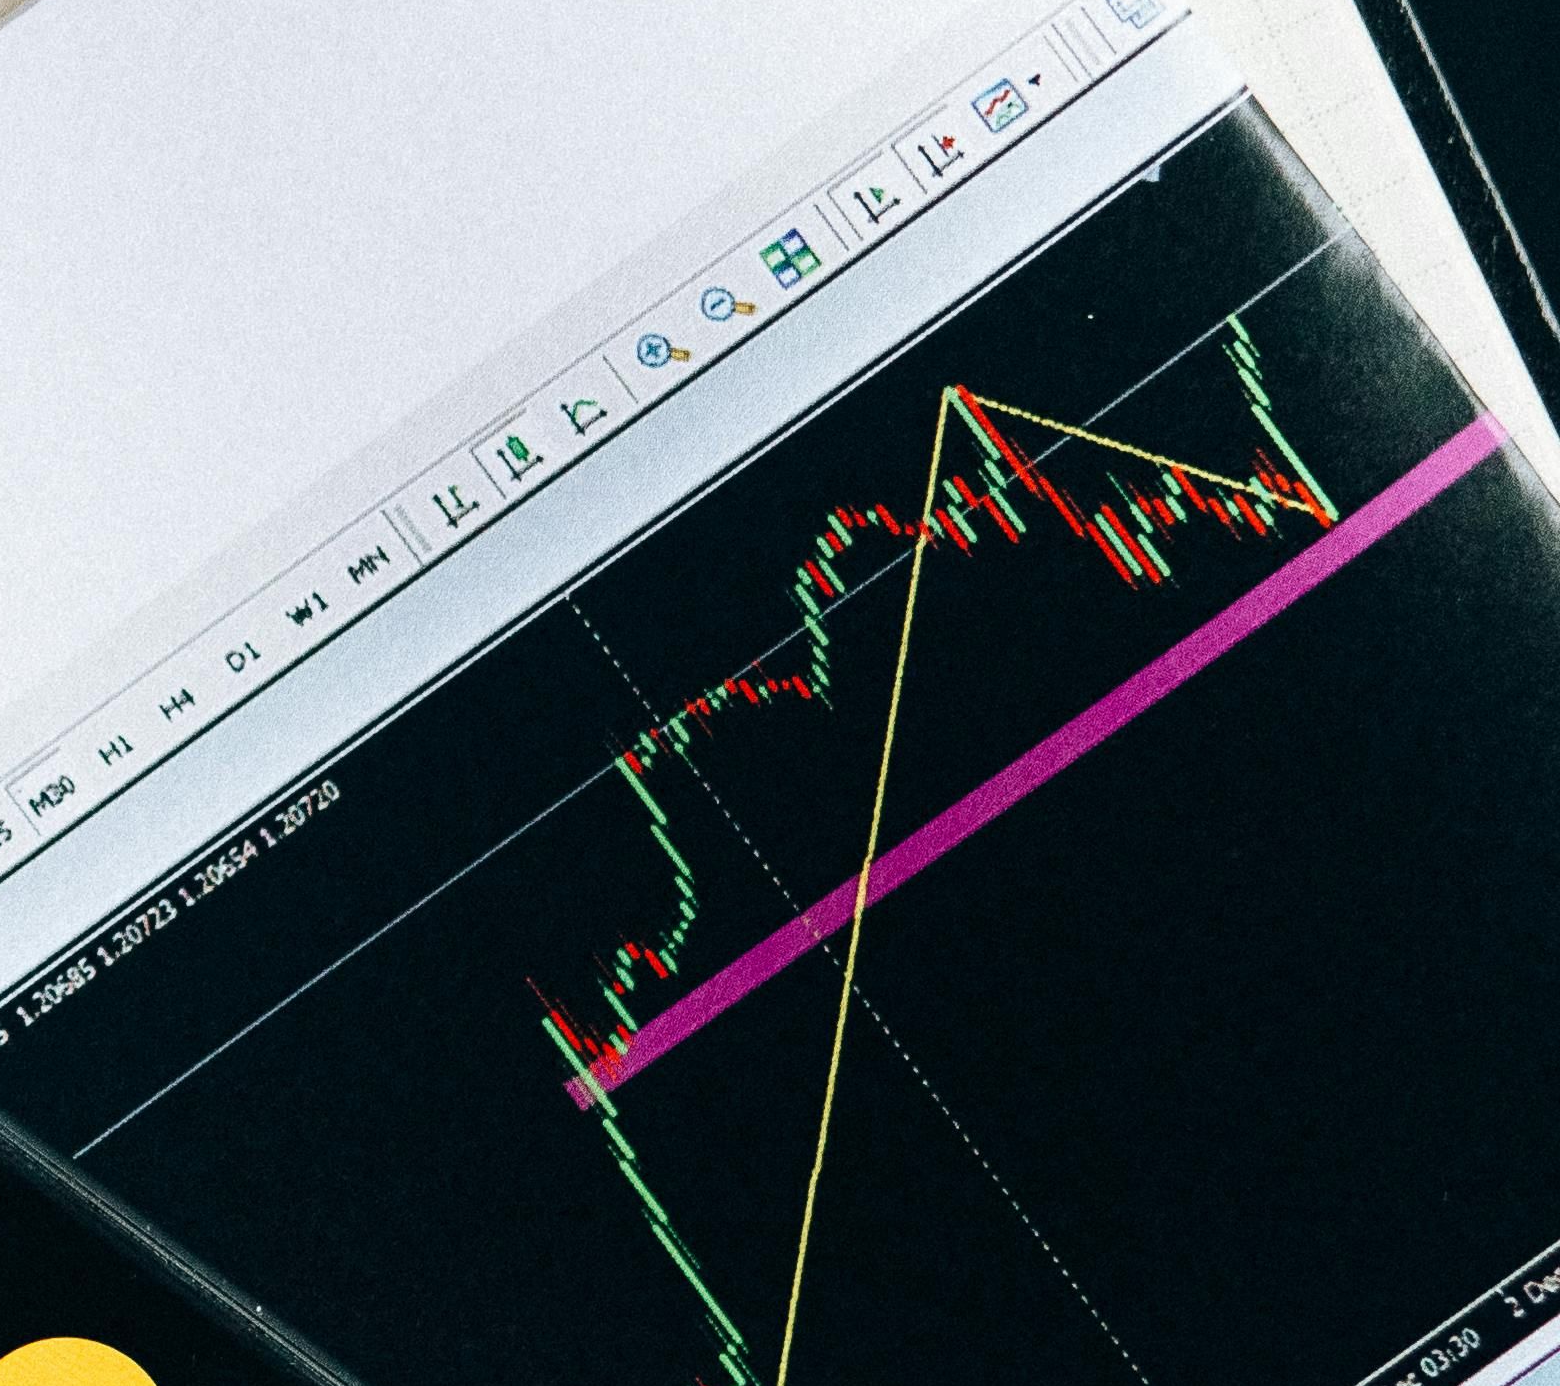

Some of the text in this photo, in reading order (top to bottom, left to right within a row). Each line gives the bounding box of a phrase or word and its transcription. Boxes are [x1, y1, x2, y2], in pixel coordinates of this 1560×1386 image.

[28, 774, 76, 819] M30
[98, 735, 134, 767] H1
[159, 687, 196, 722] H4
[285, 591, 329, 627] W1
[347, 544, 391, 584] MN
[96, 899, 177, 967] 1.20723
[258, 779, 342, 849] 1.20720
[1420, 1326, 1481, 1379] 03:30
[1504, 1295, 1526, 1319] 2
